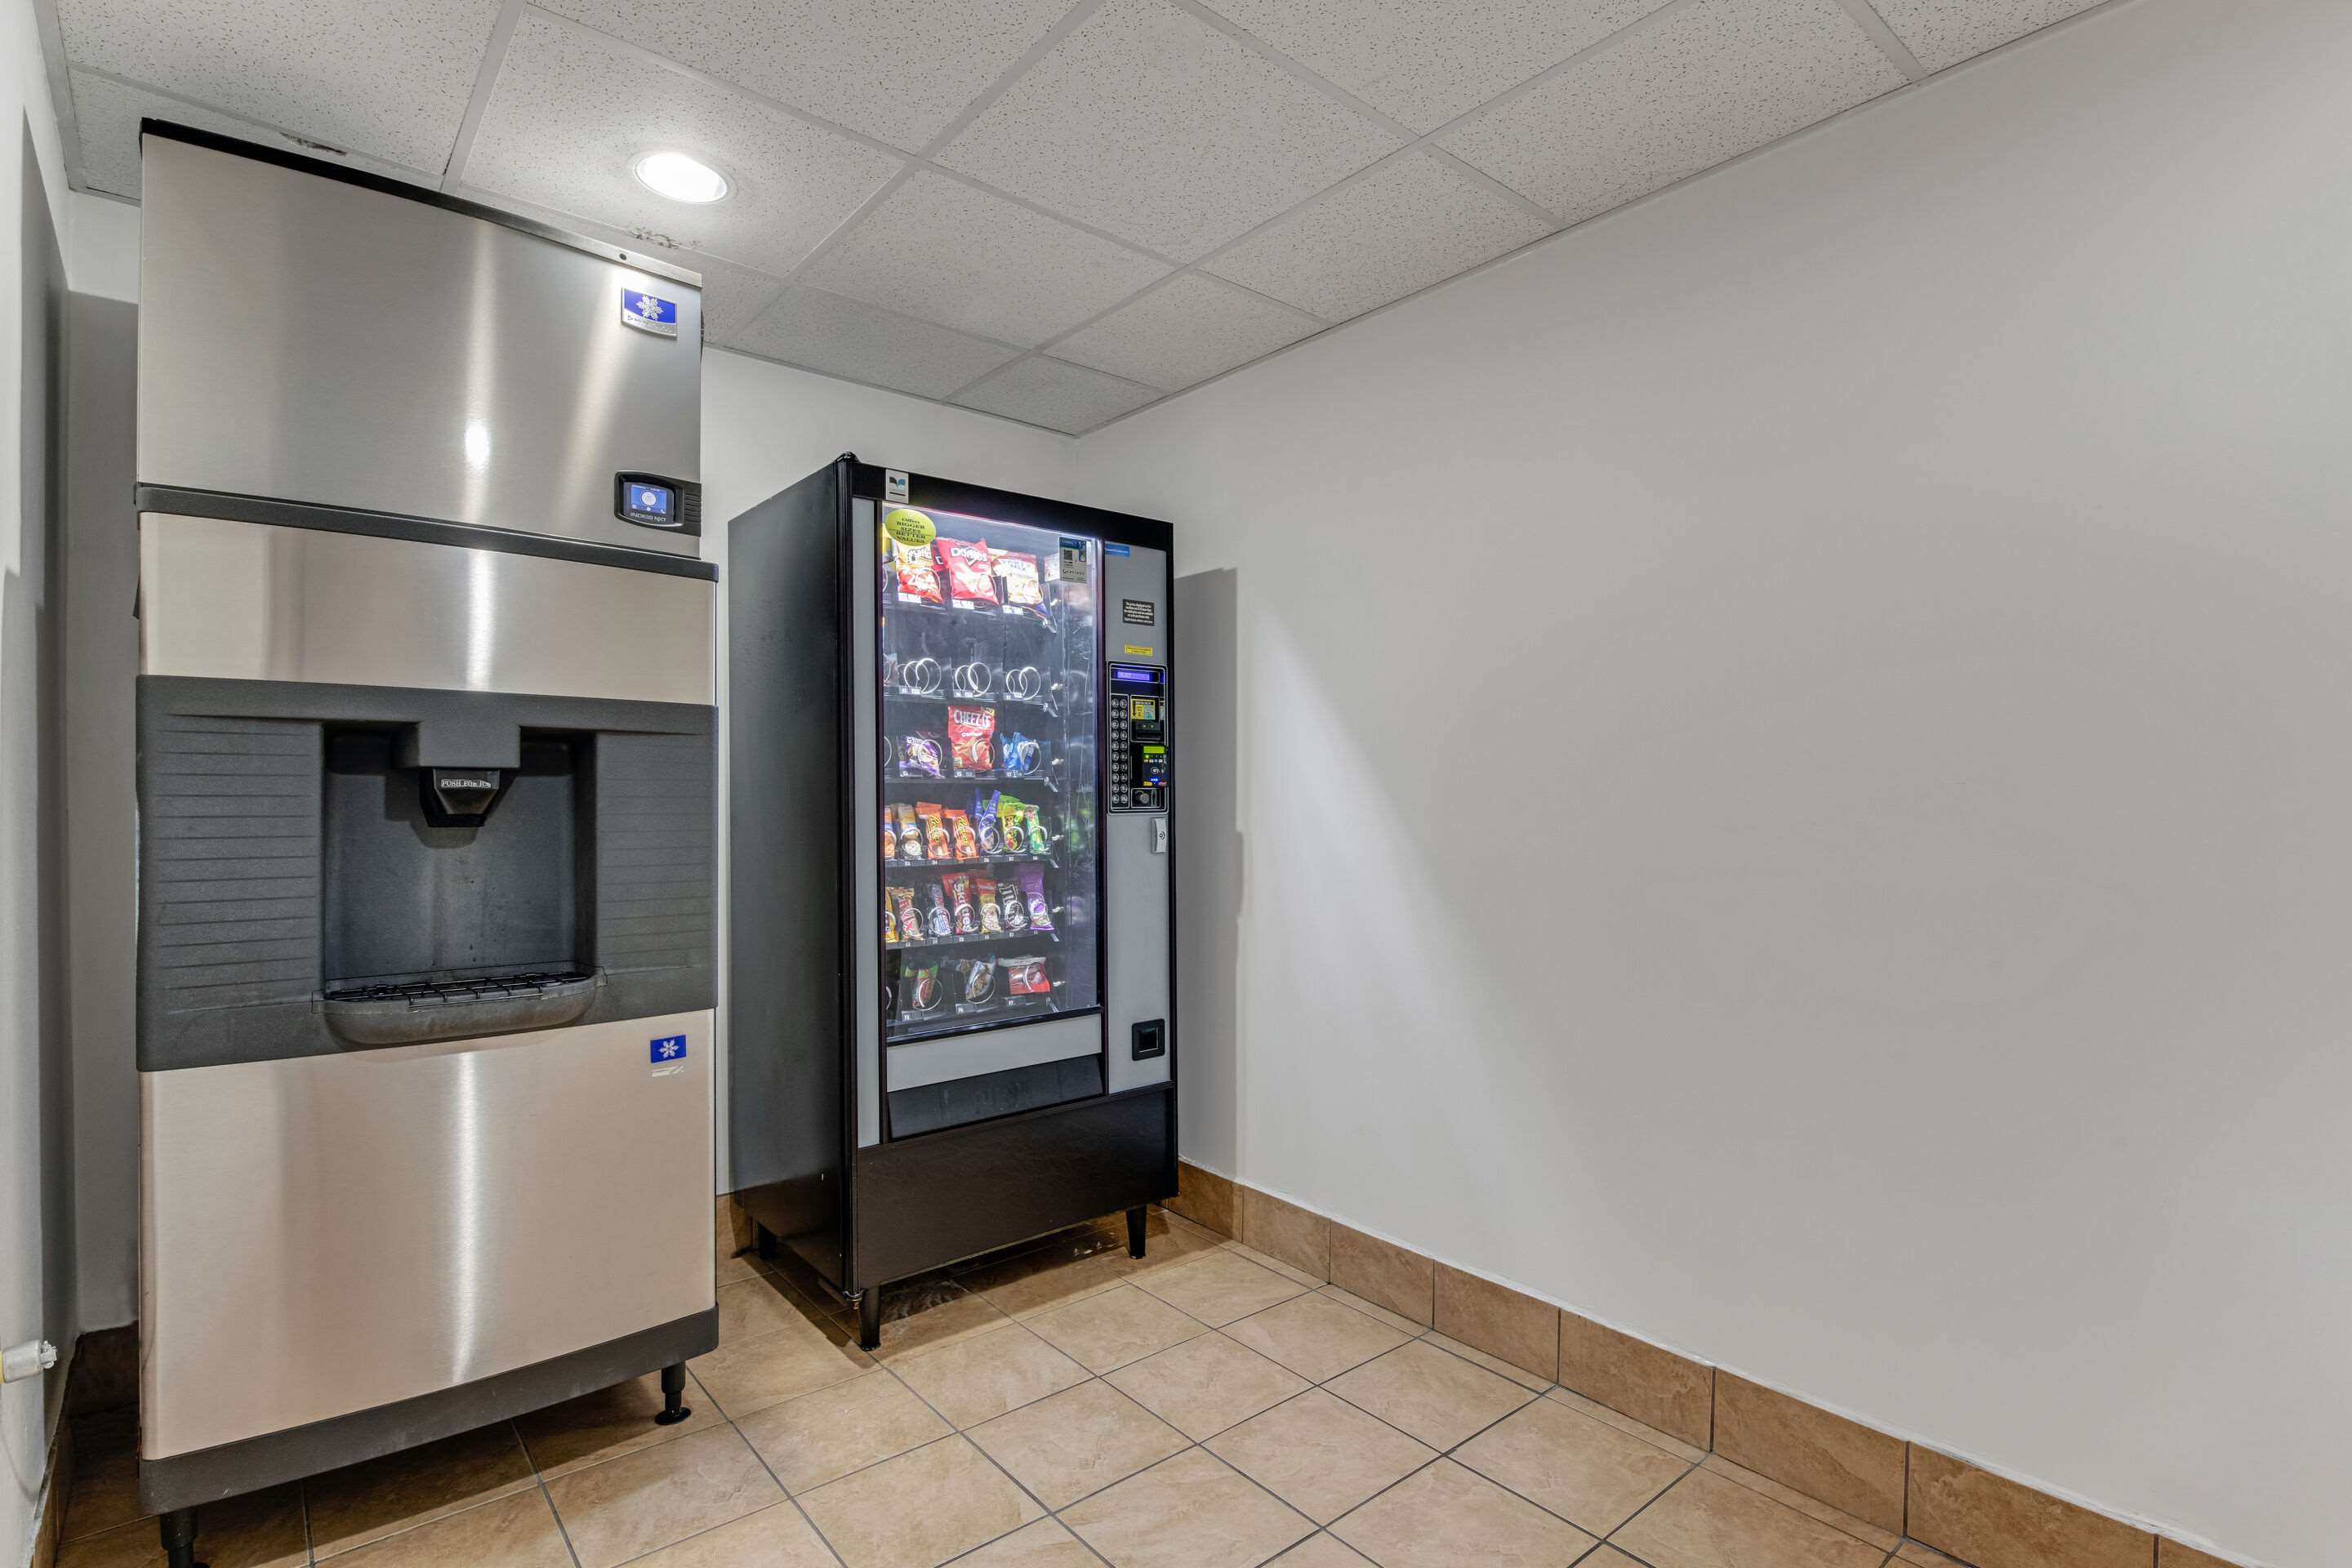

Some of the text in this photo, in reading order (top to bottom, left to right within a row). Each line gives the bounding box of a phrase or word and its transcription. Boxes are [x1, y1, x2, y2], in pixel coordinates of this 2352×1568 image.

[897, 521, 925, 529] BIGGER
[896, 531, 926, 539] BETTER
[897, 536, 925, 544] VALUES
[442, 779, 461, 788] PUSH
